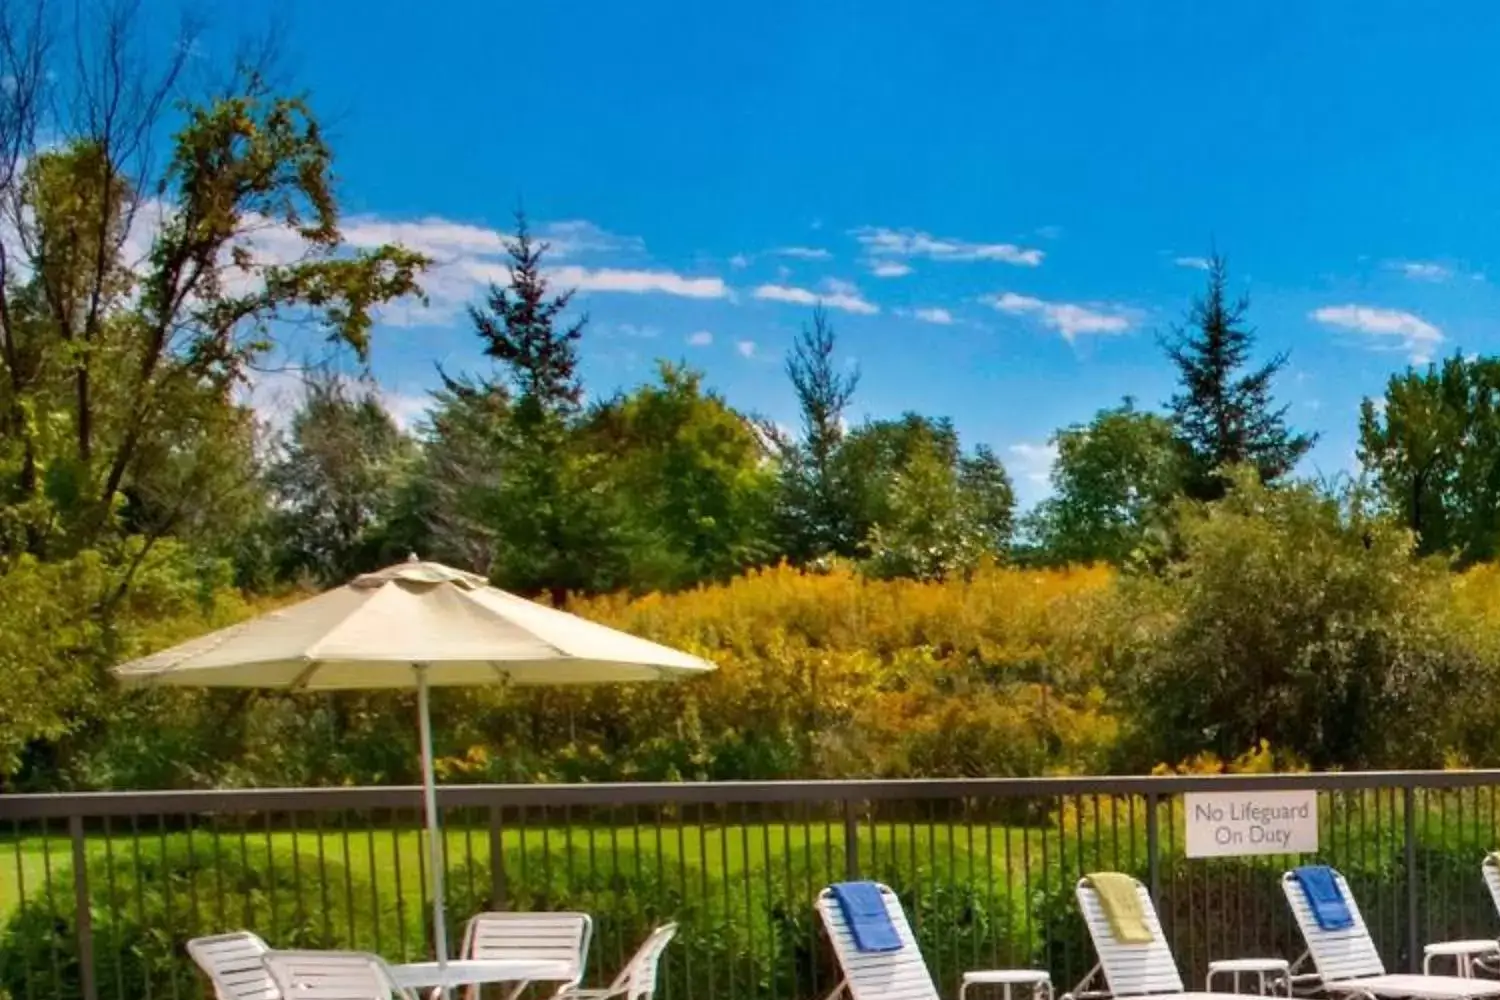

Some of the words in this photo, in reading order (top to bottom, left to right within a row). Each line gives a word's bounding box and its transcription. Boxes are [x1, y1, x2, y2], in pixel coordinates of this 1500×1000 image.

[1195, 802, 1224, 822] No
[1230, 801, 1309, 825] Lifeguard
[1215, 826, 1243, 845] On
[1250, 825, 1291, 847] Duty
